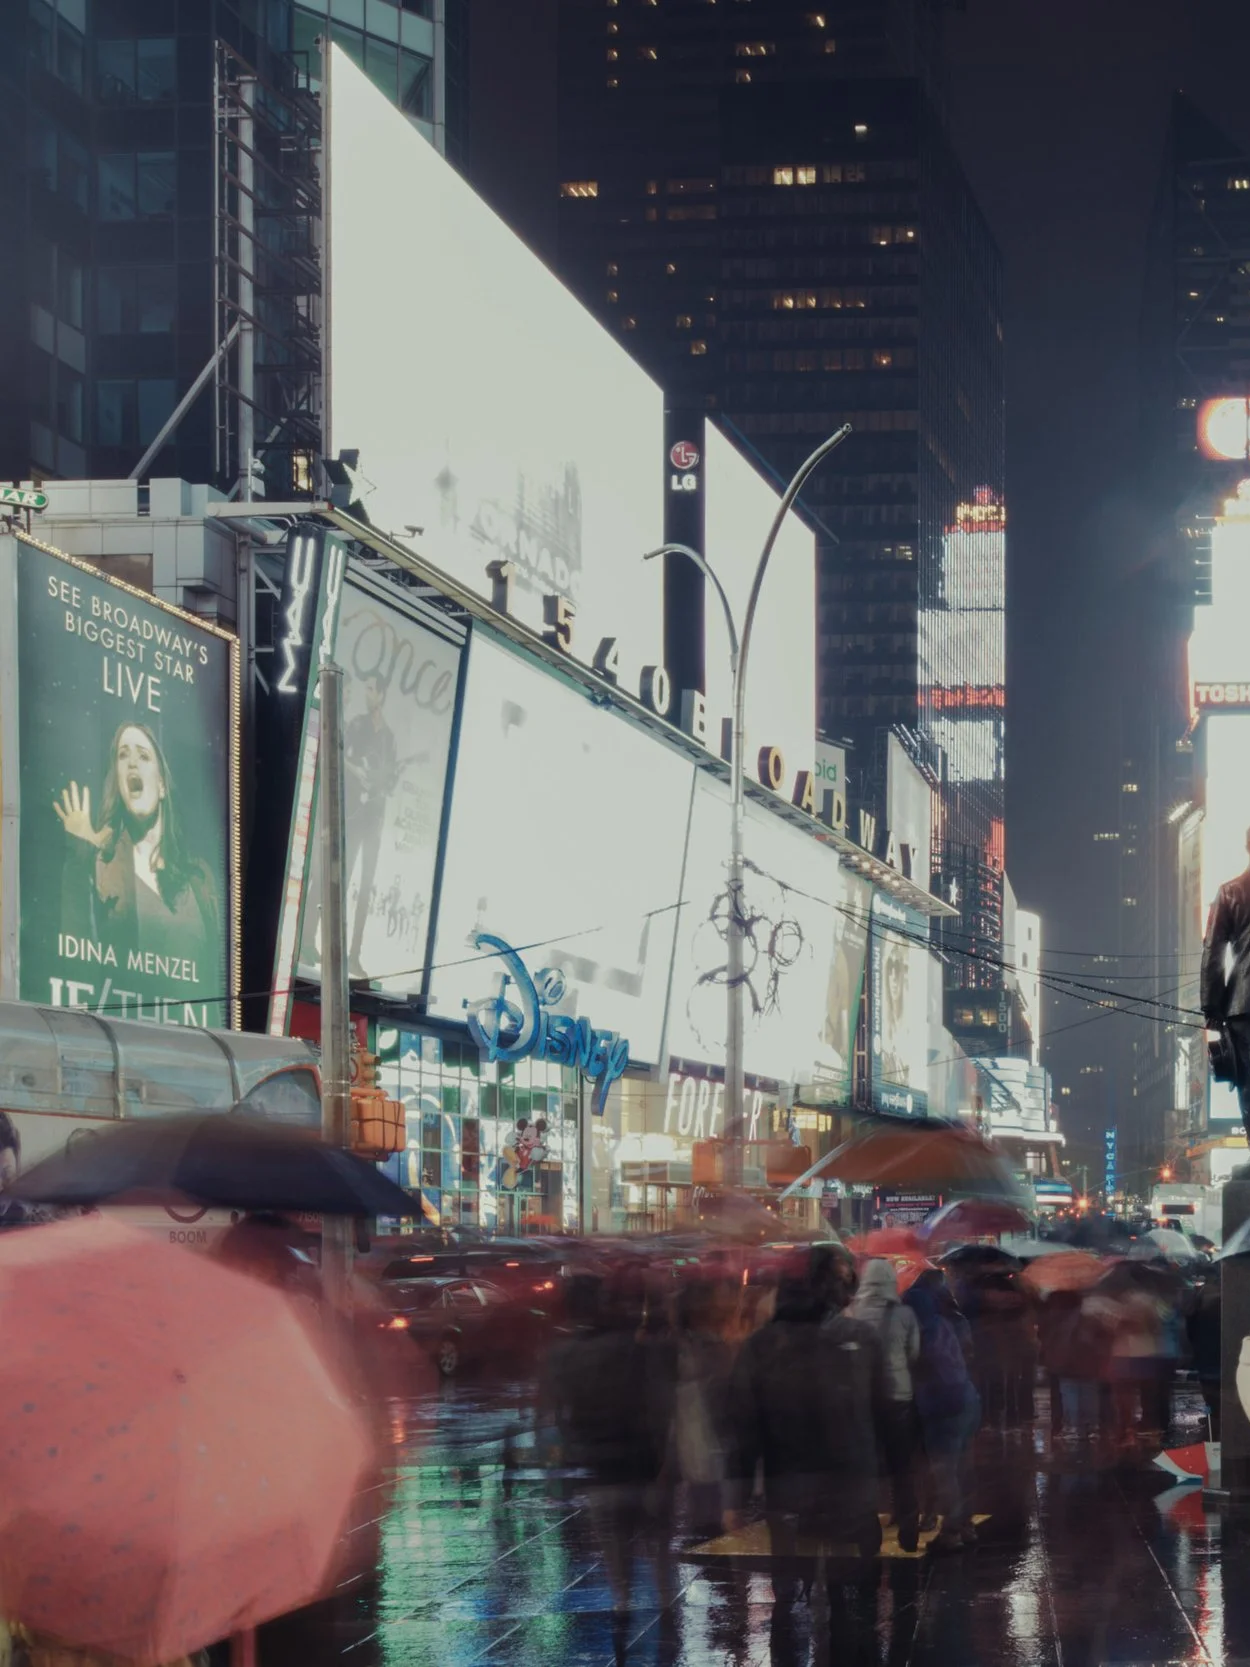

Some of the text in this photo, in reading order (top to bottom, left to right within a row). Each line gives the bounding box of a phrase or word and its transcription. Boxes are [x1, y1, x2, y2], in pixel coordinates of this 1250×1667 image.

[671, 474, 697, 490] LG
[48, 576, 208, 665] SEE BROADWAY'S
[65, 611, 194, 684] BIGGEST STAR
[103, 656, 161, 712] LIVE
[682, 688, 917, 881] BOADWAY
[58, 933, 199, 982] IDINA MENZEL
[168, 1230, 208, 1244] BOOM
